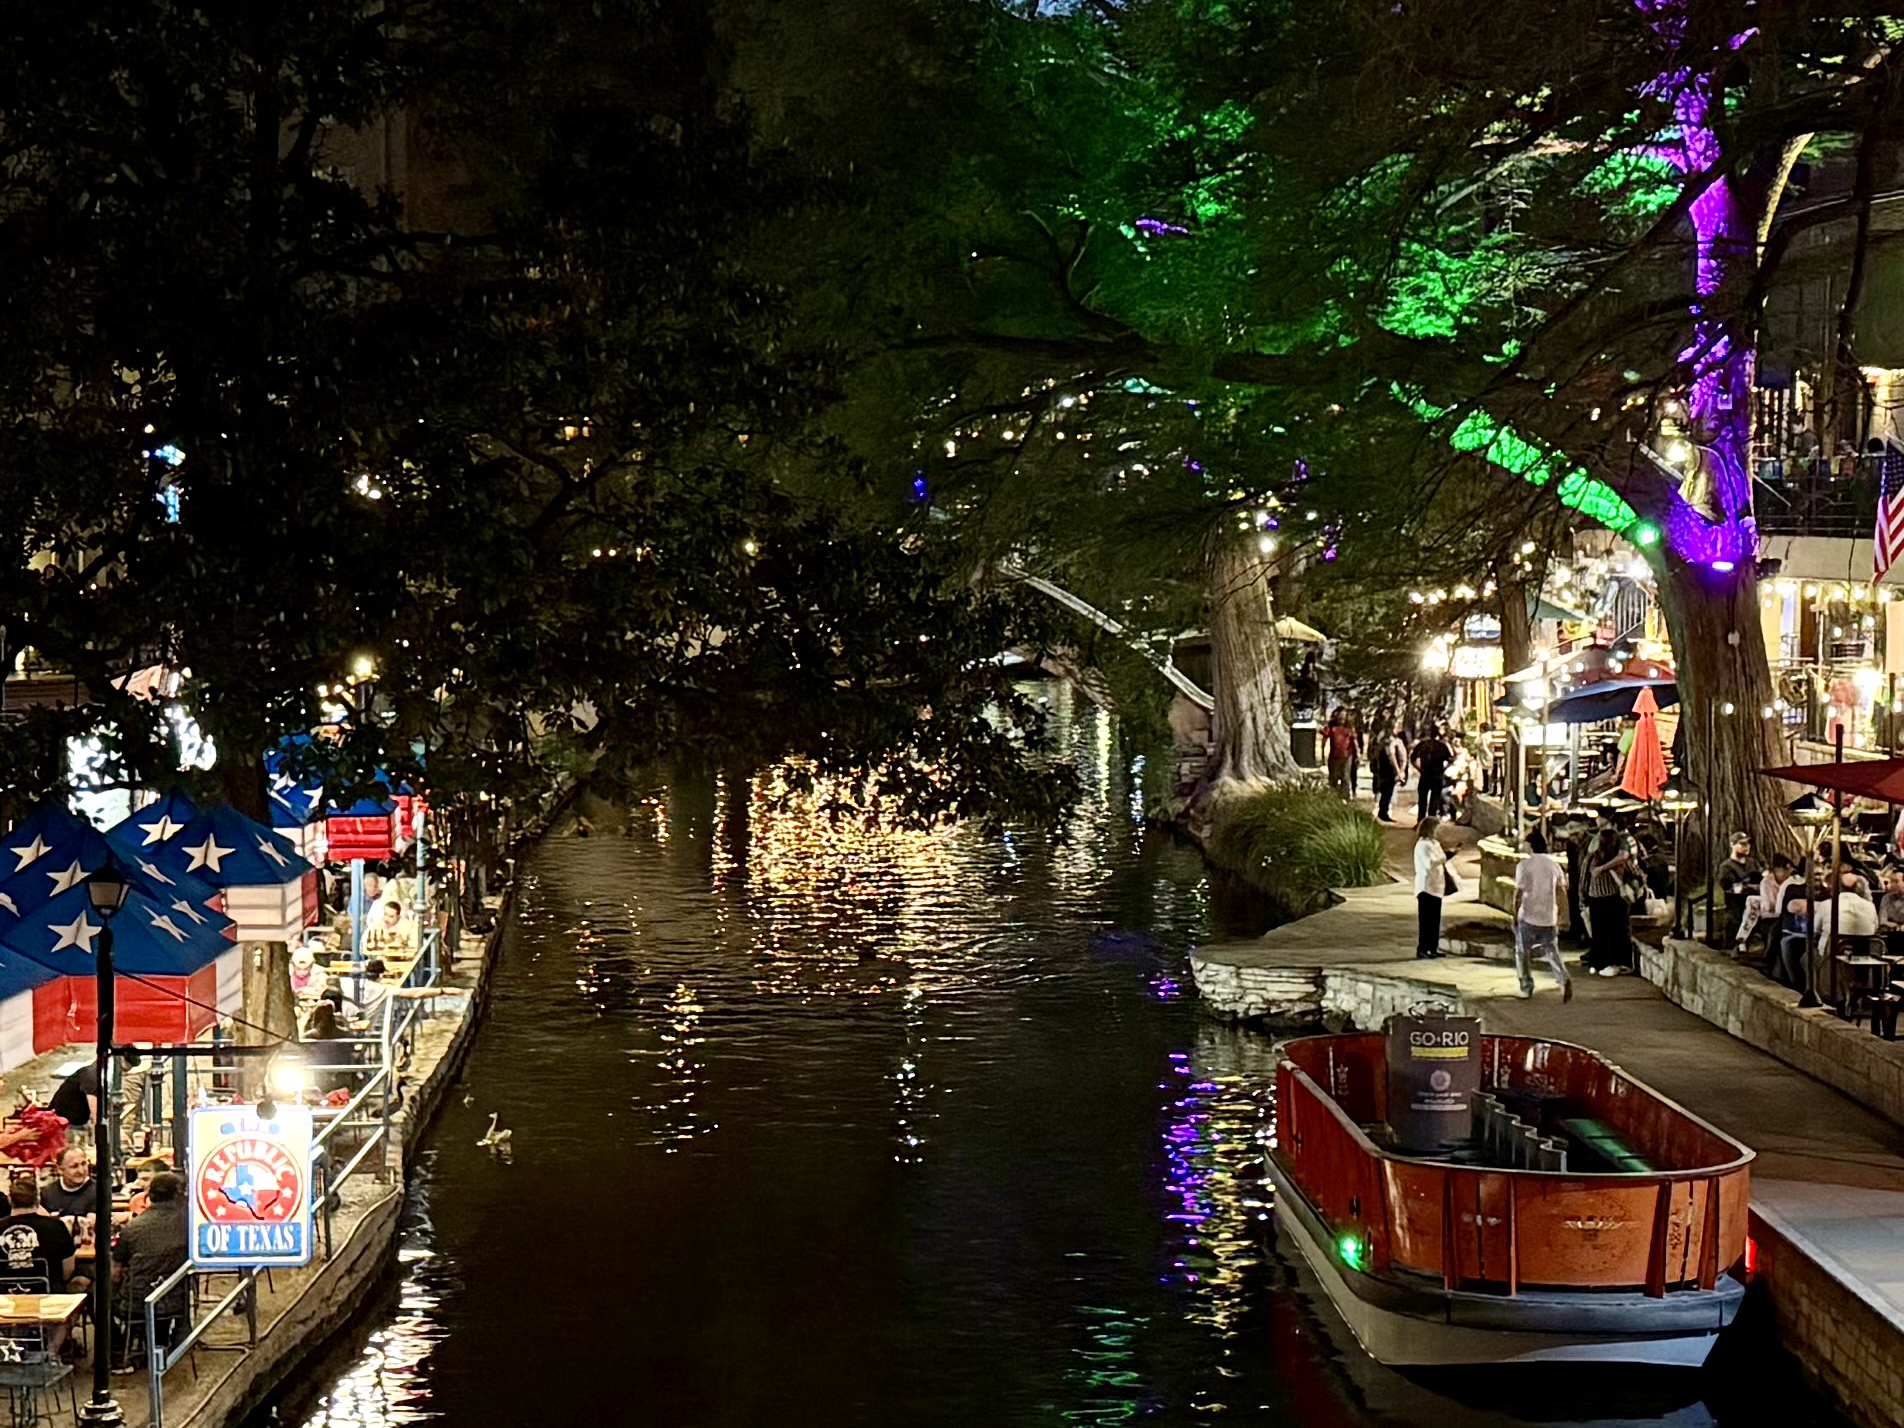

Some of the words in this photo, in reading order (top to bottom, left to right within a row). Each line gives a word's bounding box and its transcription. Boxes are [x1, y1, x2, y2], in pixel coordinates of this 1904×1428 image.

[204, 1140, 295, 1184] REPUBLIC
[207, 1225, 232, 1252] OF
[236, 1224, 294, 1252] TEXAS
